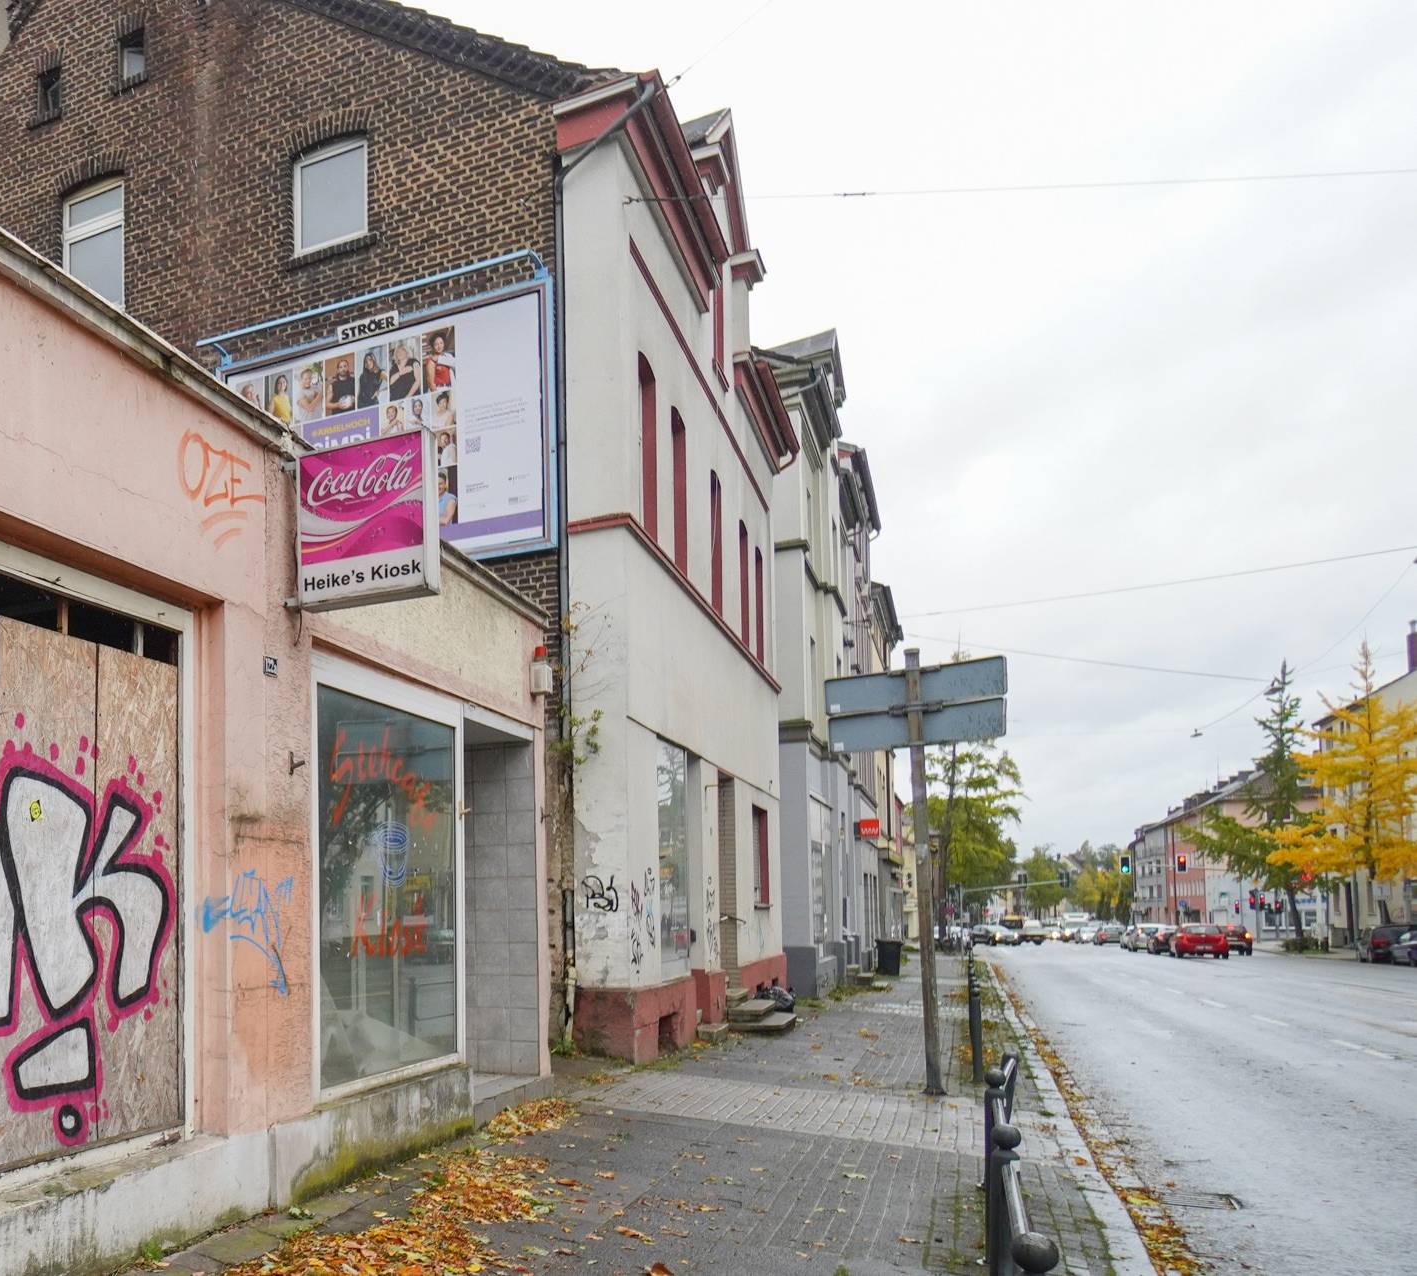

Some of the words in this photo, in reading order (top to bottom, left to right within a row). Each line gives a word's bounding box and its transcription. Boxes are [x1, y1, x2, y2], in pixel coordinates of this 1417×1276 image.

[341, 316, 396, 341] STRÖER
[304, 569, 365, 592] Heike's
[371, 559, 421, 581] Kiosk
